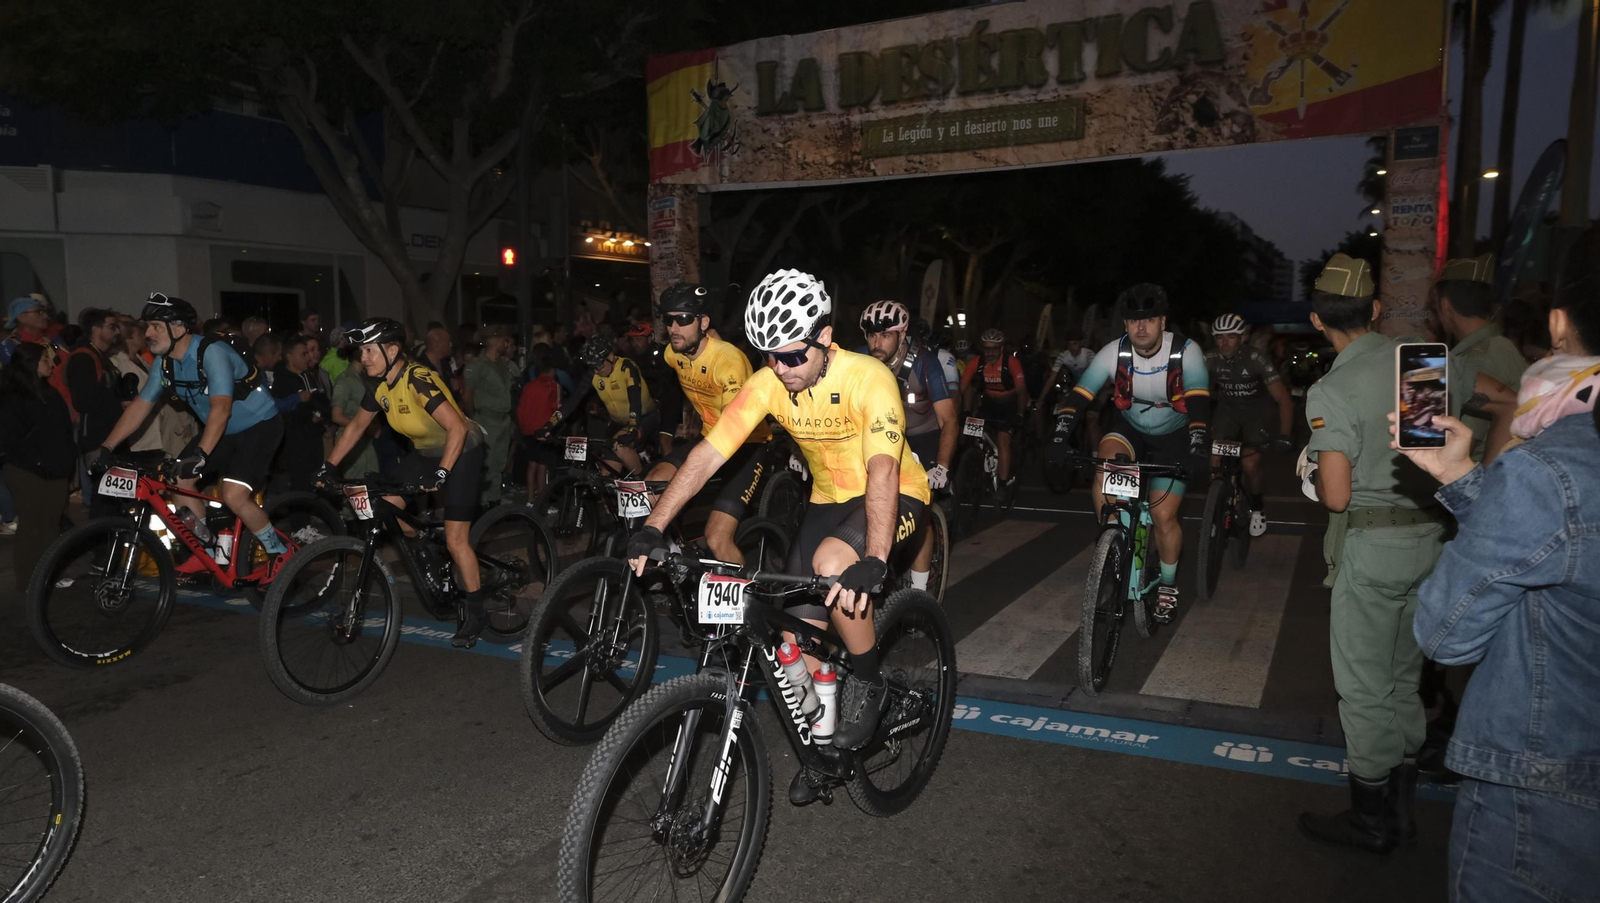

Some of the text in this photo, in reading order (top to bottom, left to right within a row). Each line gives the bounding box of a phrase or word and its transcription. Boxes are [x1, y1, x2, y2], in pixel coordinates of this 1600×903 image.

[756, 0, 1225, 115] LA DESÉRTICA
[882, 115, 1058, 143] La Legión y el desierto nos une
[1392, 203, 1433, 215] RENTA
[776, 414, 852, 428] DIMAROSA
[932, 466, 944, 481] FOX
[1110, 472, 1137, 488] 8978
[105, 475, 133, 491] 8420
[740, 462, 764, 505] kimchi
[706, 582, 741, 607] 7940
[714, 611, 735, 620] cajamar
[710, 691, 727, 701] FAST
[763, 645, 813, 746] S-WORKS
[990, 714, 1159, 744] cajamar
[1065, 733, 1151, 749] CAJA RURAL
